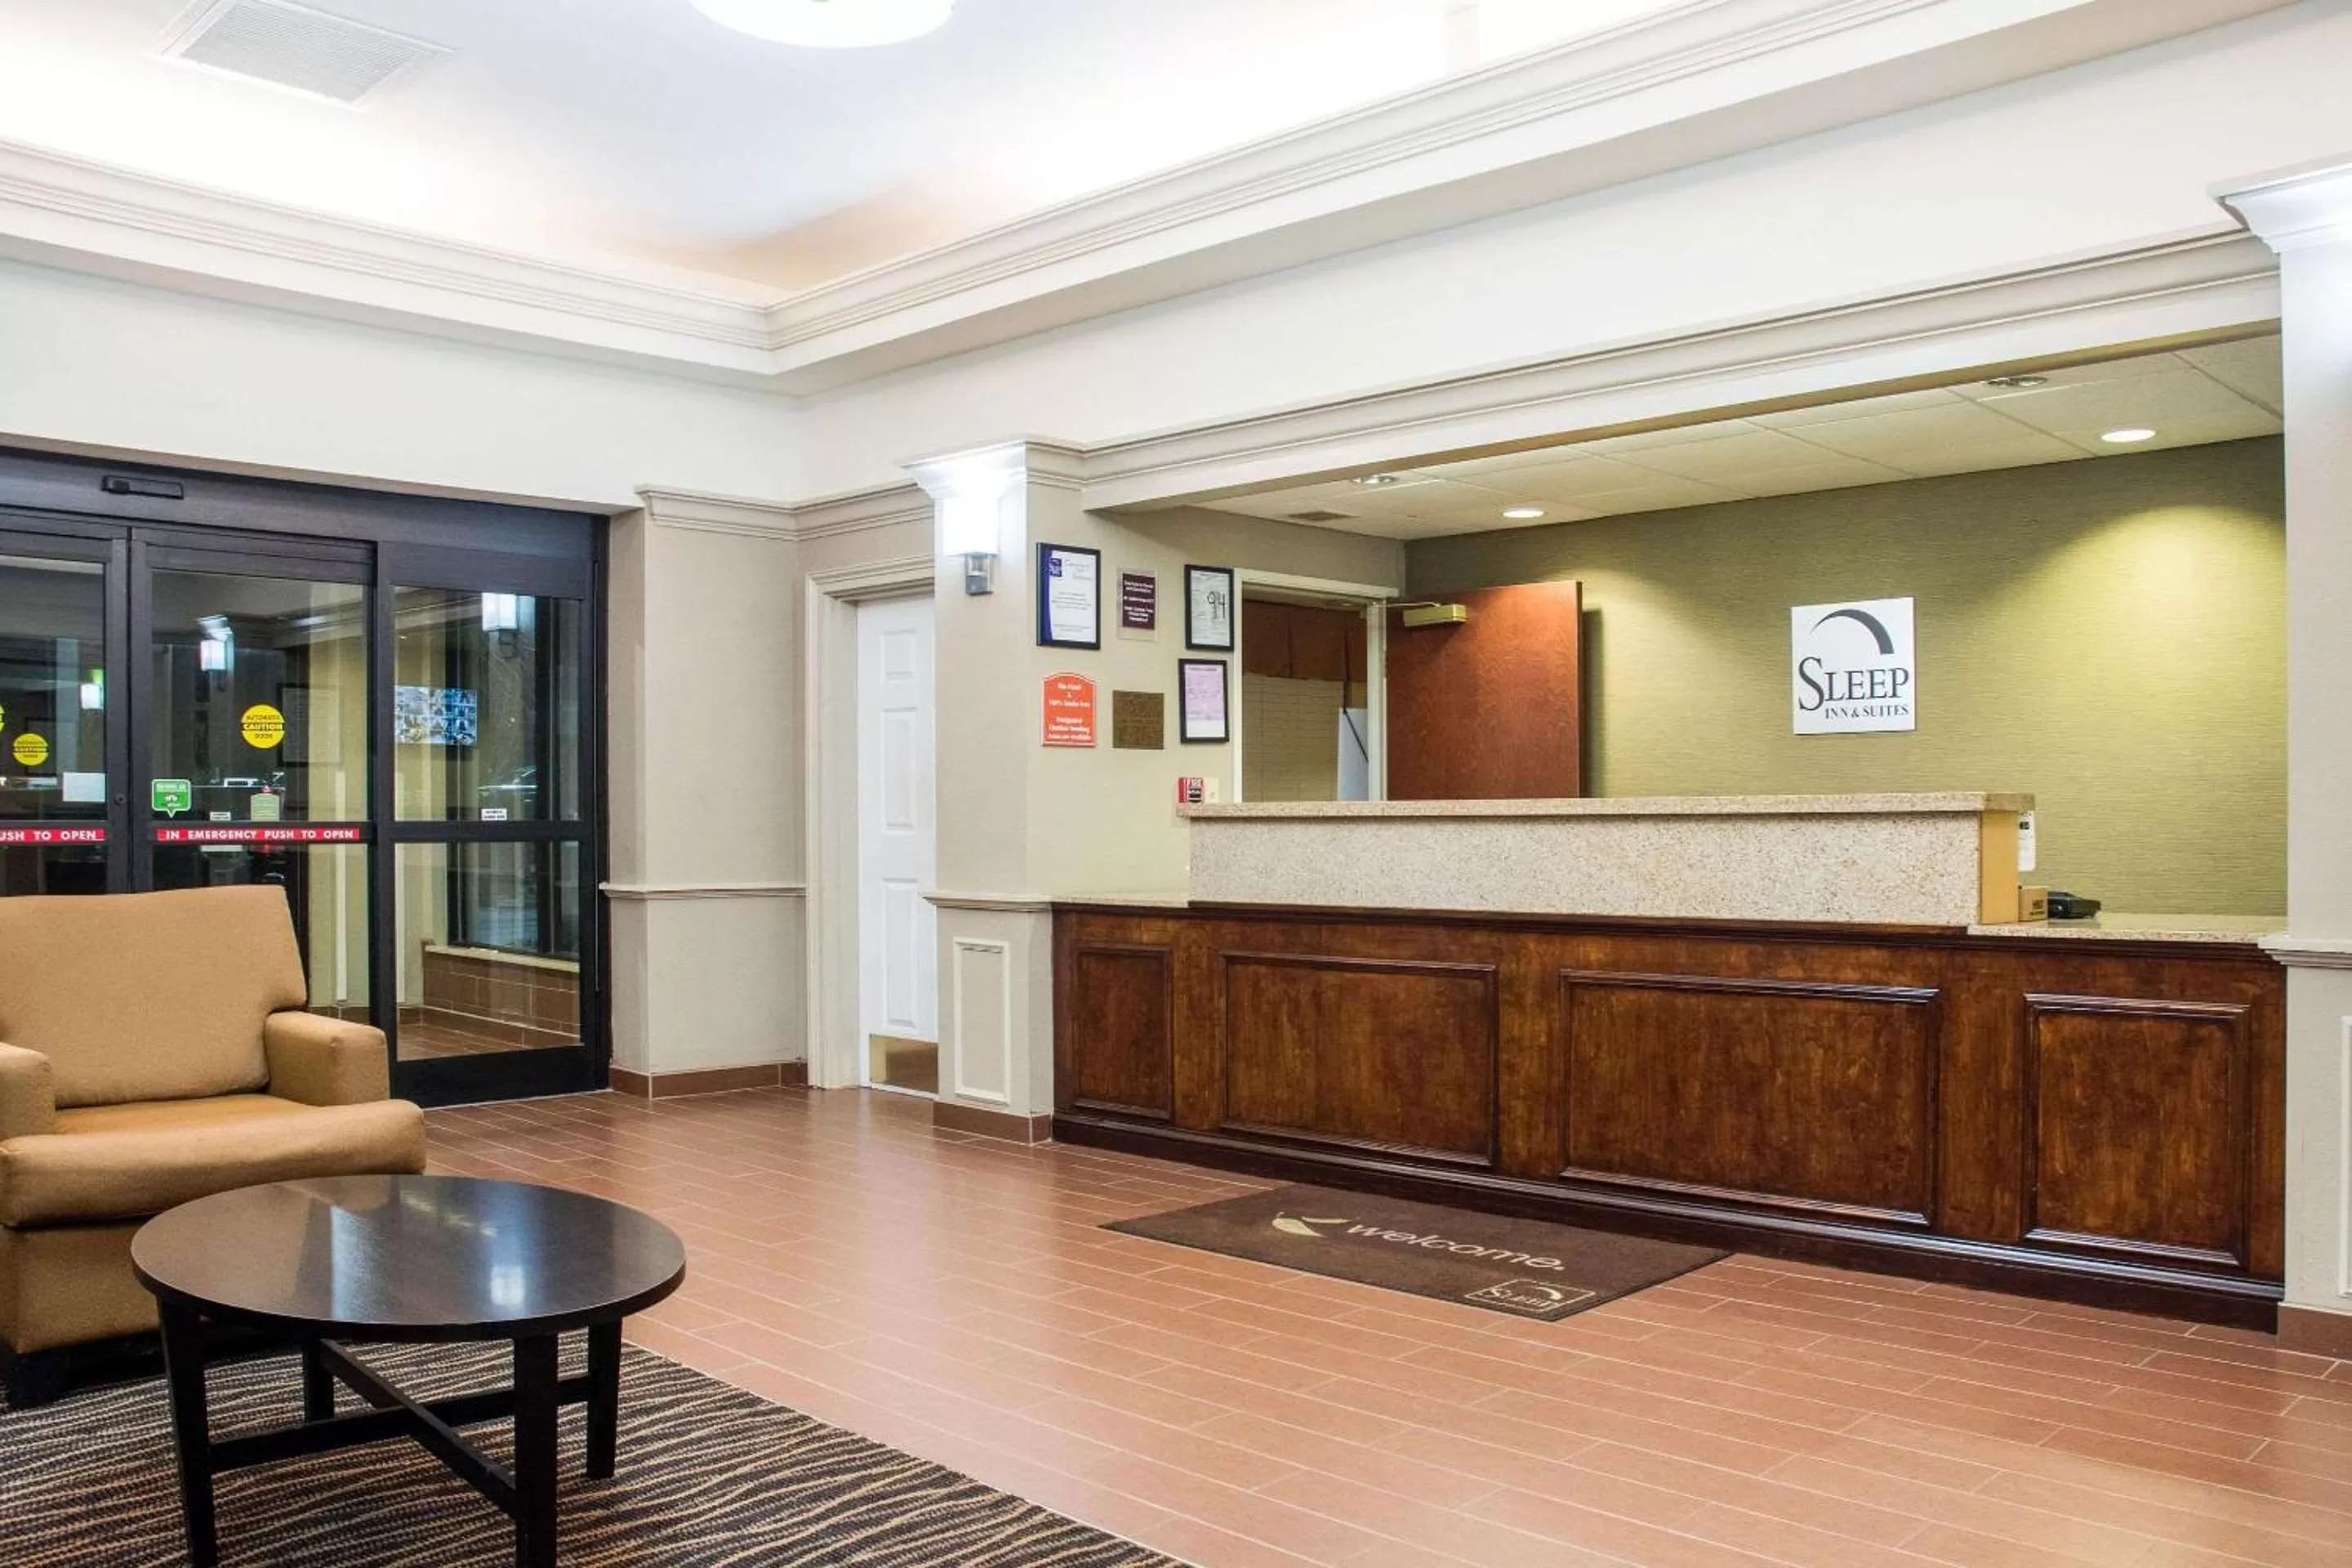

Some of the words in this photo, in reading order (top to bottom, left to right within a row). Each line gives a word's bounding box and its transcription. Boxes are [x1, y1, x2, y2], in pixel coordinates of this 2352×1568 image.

[1798, 657, 1909, 711] SLEEP
[1862, 705, 1909, 718] SUITES
[0, 830, 24, 840] USH
[34, 830, 52, 840] TO
[60, 830, 96, 840] OPEN
[166, 831, 180, 840] IN
[188, 830, 256, 840] EMERGENCY
[265, 830, 294, 840] PUSH
[301, 830, 317, 840] TO
[323, 830, 354, 840] OPEN
